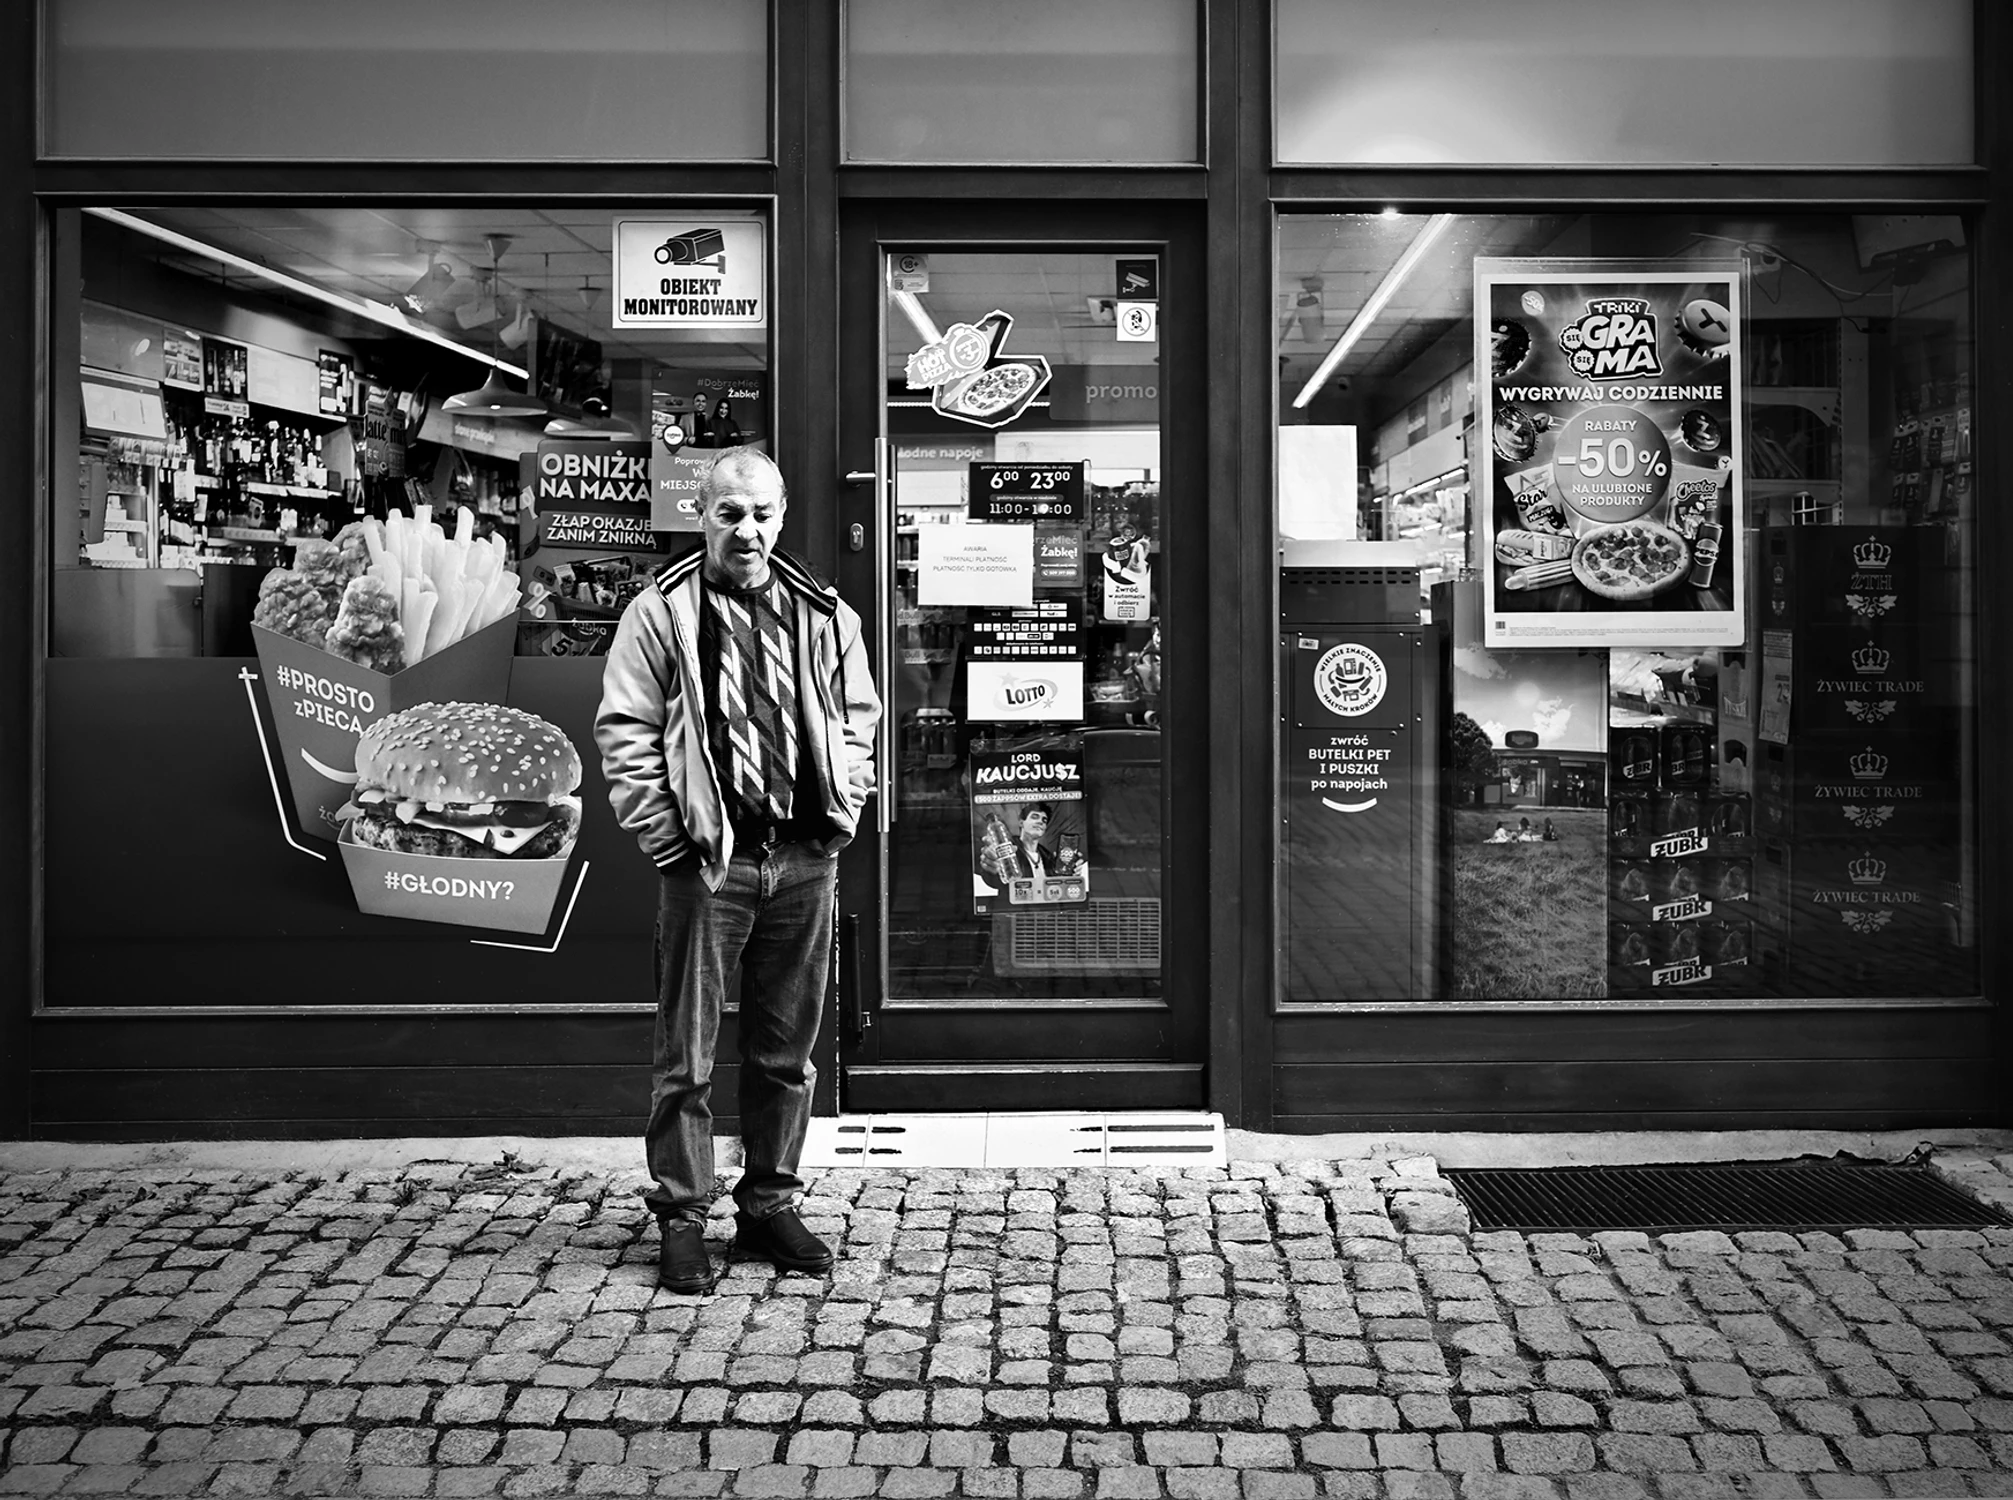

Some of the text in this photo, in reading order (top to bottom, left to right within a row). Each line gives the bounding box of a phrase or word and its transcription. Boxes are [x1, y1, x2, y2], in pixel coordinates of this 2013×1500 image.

[660, 278, 721, 295] OBIEKT
[624, 298, 758, 316] MONITOROWANY
[1581, 314, 1656, 350] GRA
[1594, 345, 1658, 375] MA
[697, 378, 760, 390] #DobrzeMieć
[728, 388, 760, 400] Żabkę!
[1085, 385, 1158, 403] promo
[1499, 386, 1723, 401] WYGRYWAJ CODZIENNIE
[1585, 420, 1637, 432] RABATY
[940, 446, 984, 461] napoje
[1558, 437, 1668, 478] -50%
[540, 477, 652, 503] NA MAXA
[1572, 483, 1653, 494] NA ULUBIONE
[1678, 481, 1717, 499] Cheetos
[1517, 488, 1548, 512] Star
[1580, 495, 1645, 506] PRODUKTY
[552, 514, 652, 532] ZŁAP OKAZJE
[547, 528, 657, 549] ZANIM ZNIKNĄ
[1040, 544, 1078, 560] Żabkę!
[1319, 648, 1344, 672] WIELKIE
[1345, 648, 1382, 672] ZNACZENIE
[277, 664, 375, 713] #PROSTO
[1817, 679, 1924, 692] ŻYWIEC TRADE
[1005, 685, 1046, 705] LOTTO
[1323, 693, 1349, 712] MAŁYCH
[1349, 693, 1378, 712] KROKÓW
[1330, 734, 1369, 746] zwróć
[1011, 753, 1041, 763] LORD
[1308, 748, 1392, 760] BUTELKI PET
[1320, 763, 1379, 775] I PUSZKI
[1311, 778, 1388, 793] po napojach
[1814, 784, 1922, 798] ŻYWIEC TRADE
[1655, 837, 1704, 856] ZUBR
[384, 870, 516, 902] #GŁODNY?
[1812, 889, 1920, 903] ŻYWIEC TRADE
[1658, 901, 1707, 919] ZUBR
[1658, 965, 1707, 984] ZUBR
